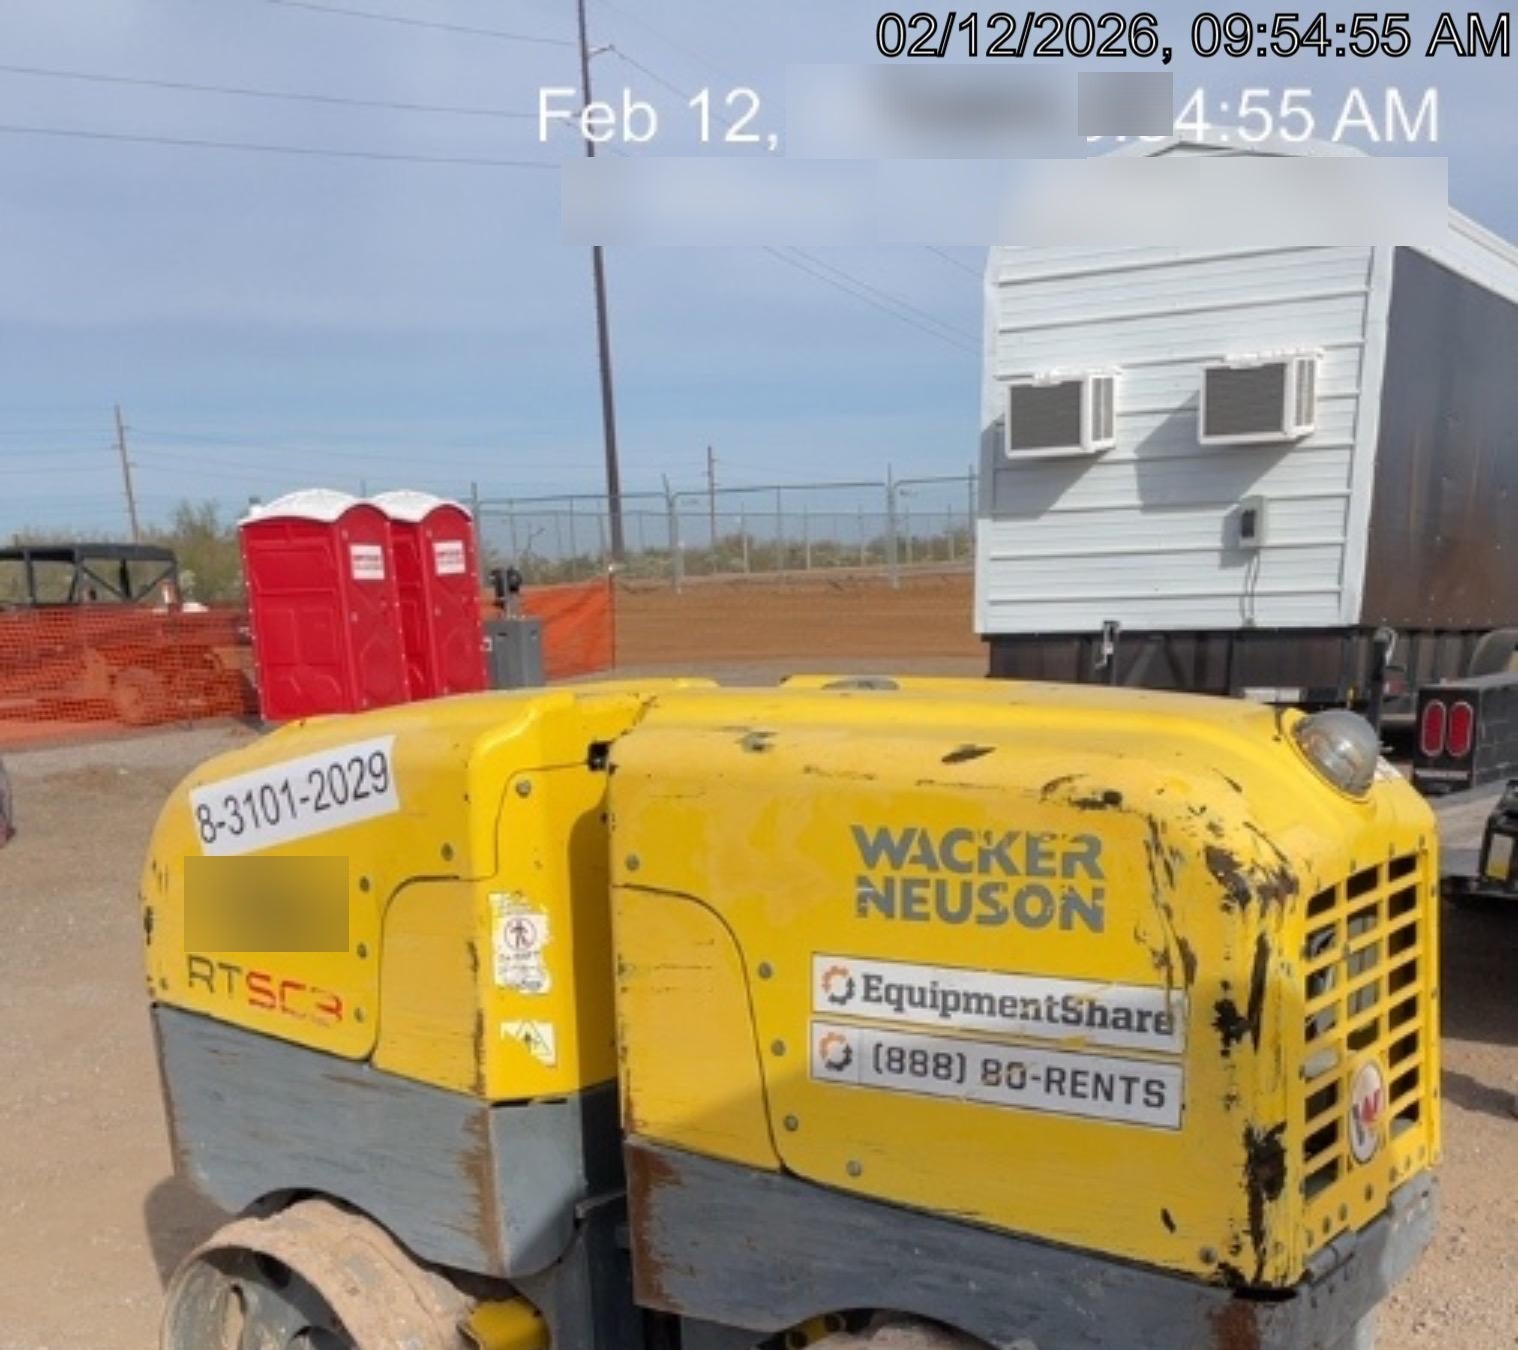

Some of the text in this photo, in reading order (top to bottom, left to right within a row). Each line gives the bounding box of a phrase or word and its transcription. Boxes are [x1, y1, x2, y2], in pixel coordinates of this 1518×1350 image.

[196, 751, 389, 844] 8-3101-2029
[850, 825, 1105, 880] WACKER
[856, 877, 1104, 933] NEUSON
[861, 973, 1175, 1036] EquipmentShare
[872, 1043, 1167, 1109] (888) 80-RENTS
